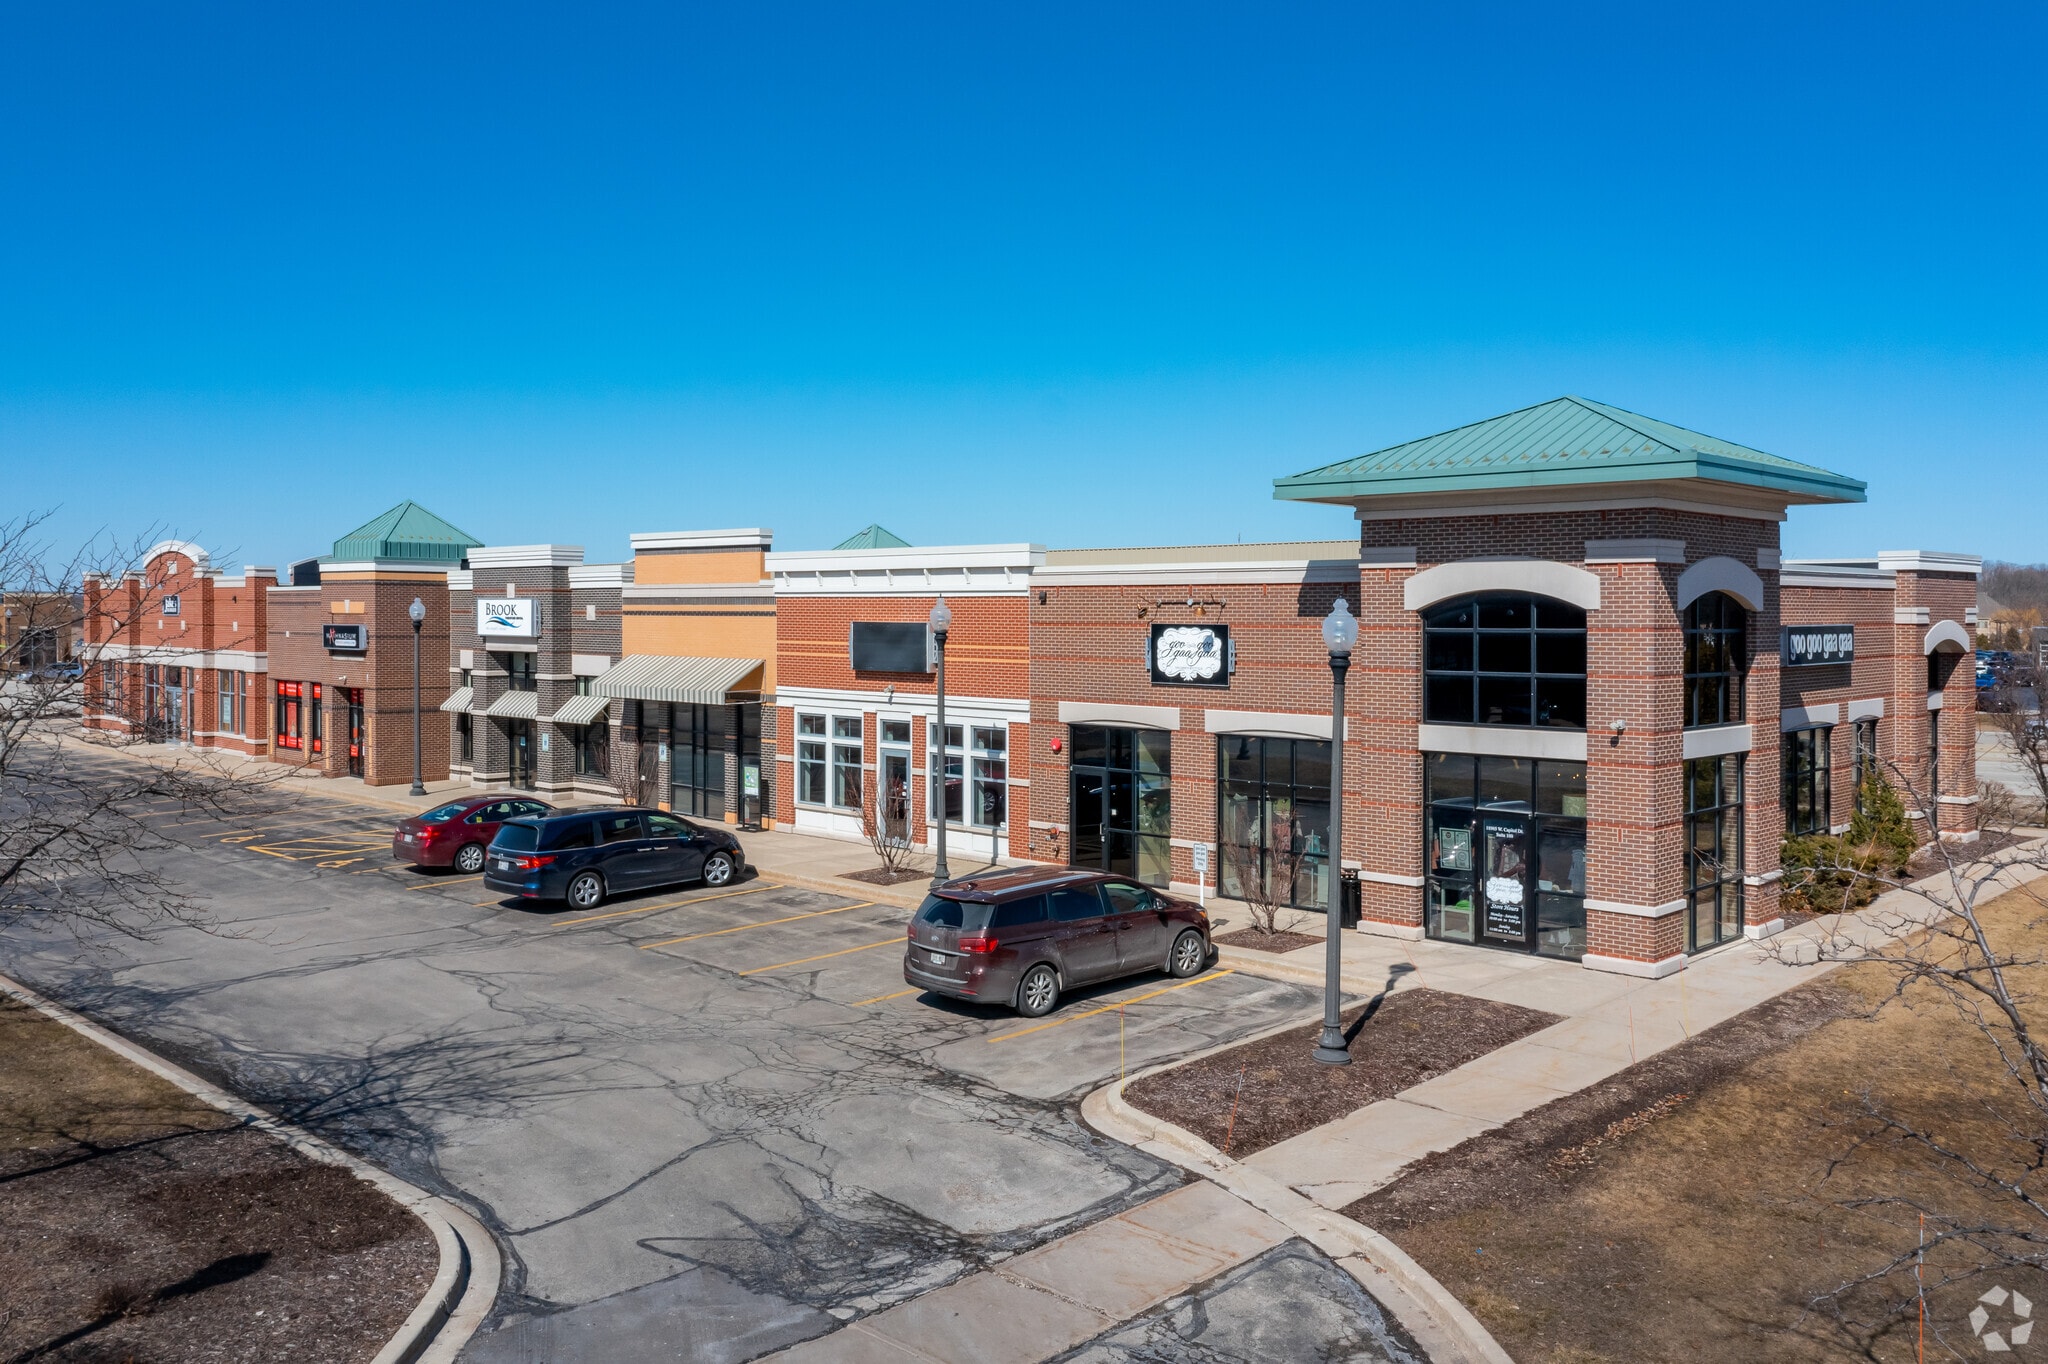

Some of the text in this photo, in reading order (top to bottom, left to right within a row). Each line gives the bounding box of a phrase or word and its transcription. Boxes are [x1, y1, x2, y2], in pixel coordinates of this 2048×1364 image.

[485, 602, 518, 616] BROOK
[1161, 640, 1186, 658] goo
[1790, 633, 1853, 660] goo goo gaa gaa
[1167, 650, 1191, 667] gaa
